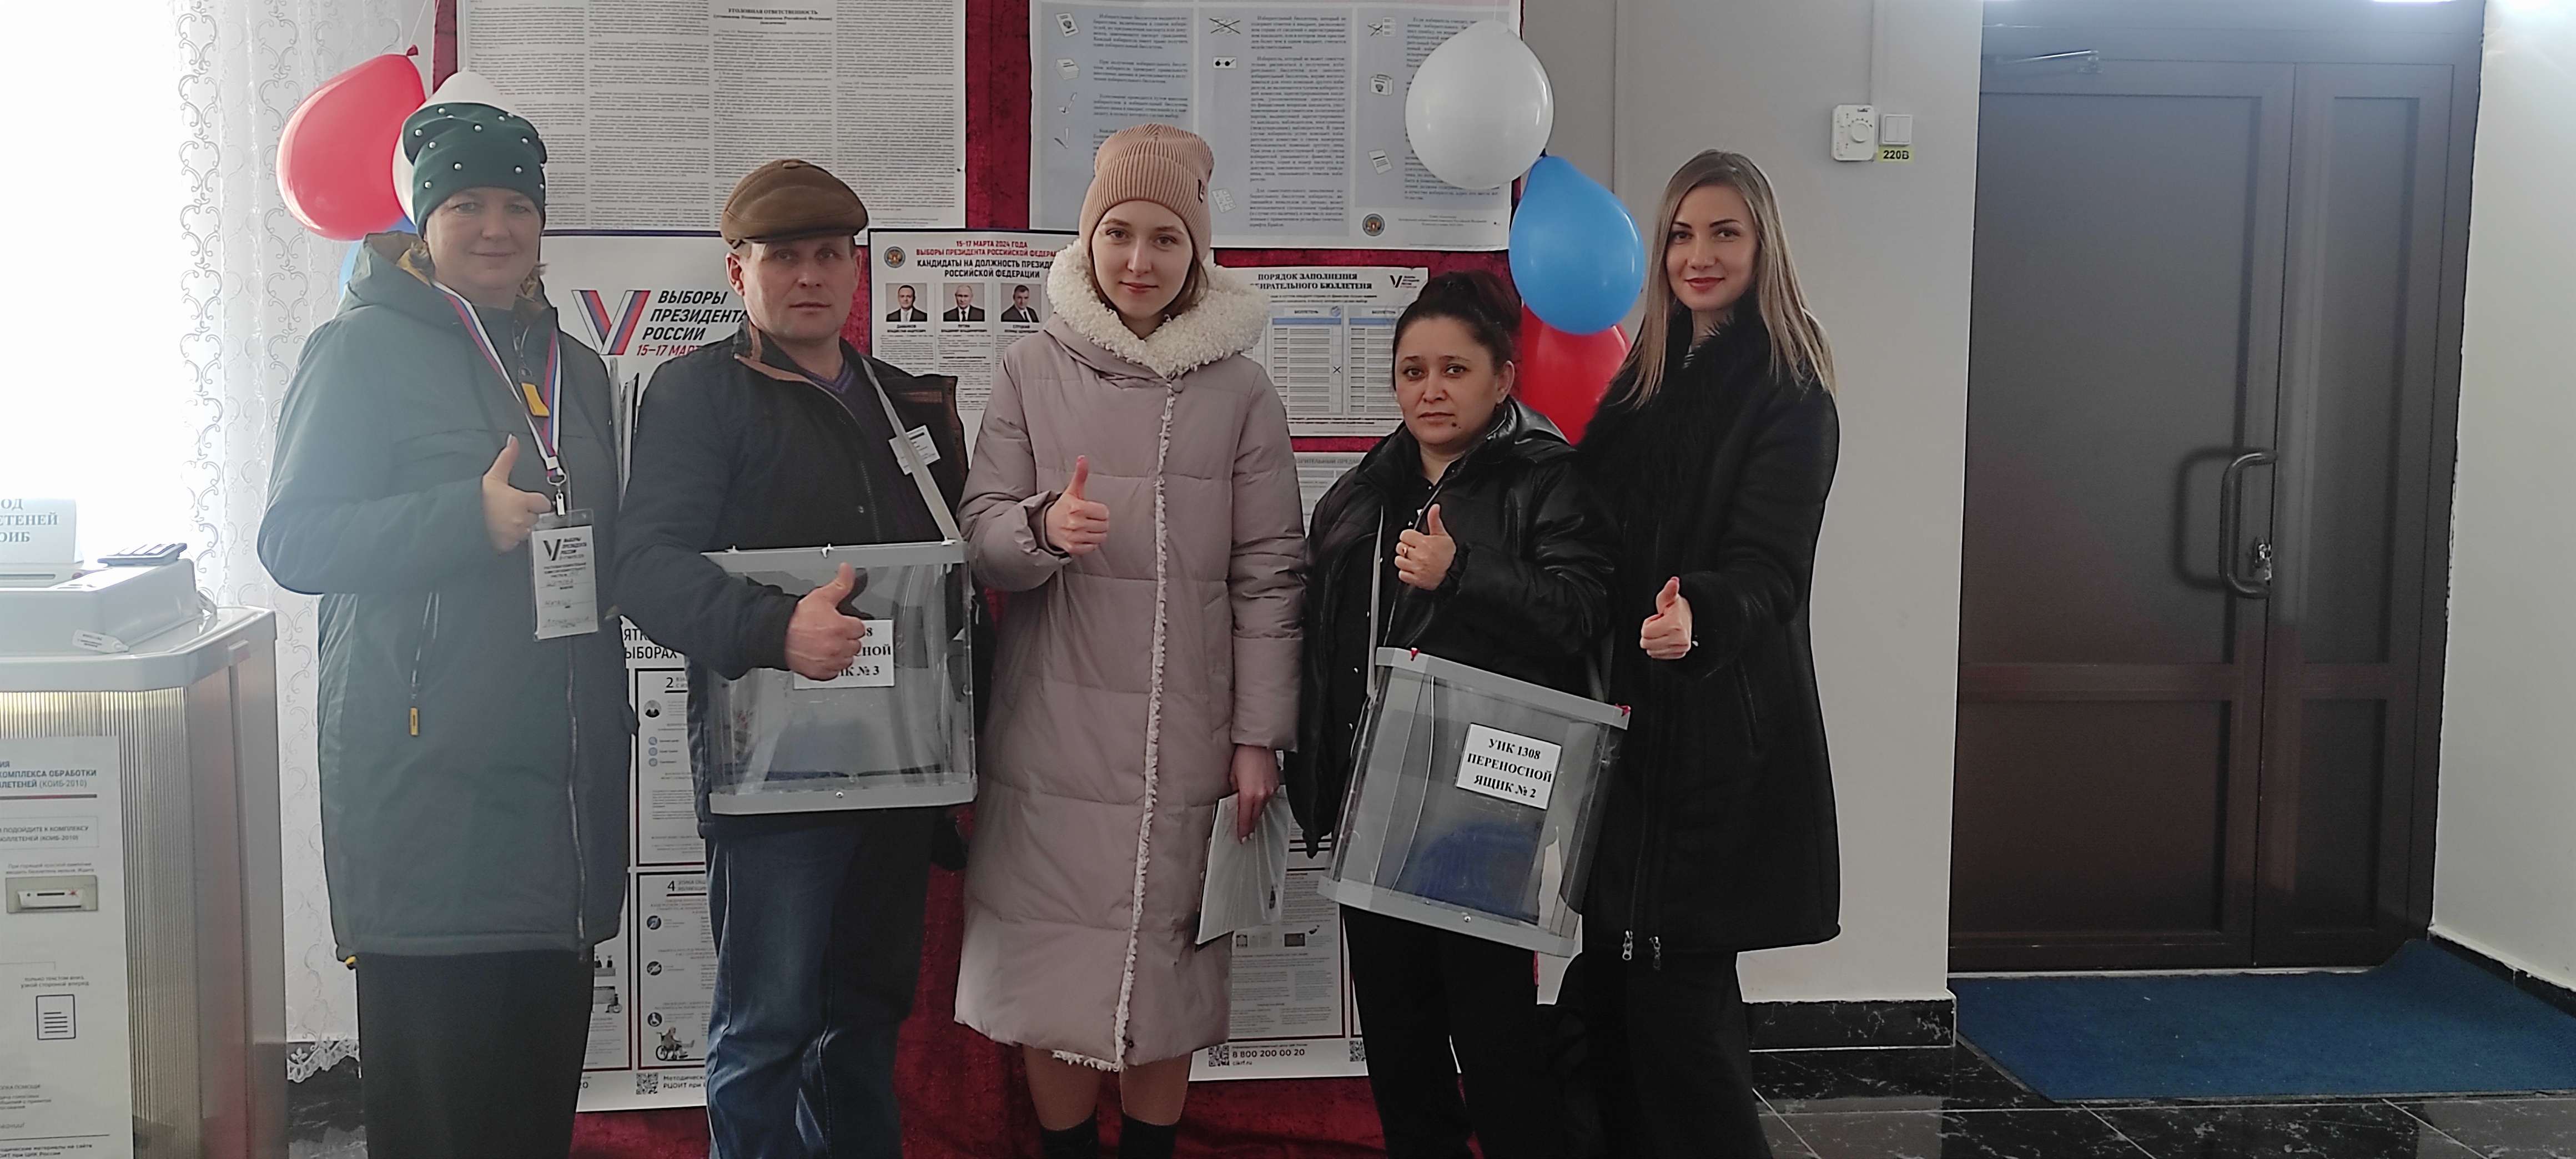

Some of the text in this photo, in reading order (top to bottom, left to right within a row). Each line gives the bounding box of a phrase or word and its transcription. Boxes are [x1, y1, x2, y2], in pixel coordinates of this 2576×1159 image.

[917, 259, 962, 268] КАНДИДАТЫ
[974, 259, 1020, 268] ДОЛЖНОСТЬ
[944, 268, 1040, 279] РОССИЙСКОЙ ФЕДЕРАЦИИ
[658, 290, 728, 305] ВЫБОРЫ
[642, 327, 706, 341] РОССИИ
[668, 345, 701, 356] МАР
[873, 666, 879, 676] 3
[666, 677, 674, 688] 2
[1488, 738, 1541, 760] УИК 1308
[1467, 753, 1552, 783] ПЕРЕНОСНОЙ
[39, 779, 87, 789] (КОИБ-2010)
[1473, 775, 1537, 798] ЯЩИК № 2
[667, 880, 675, 891] 4
